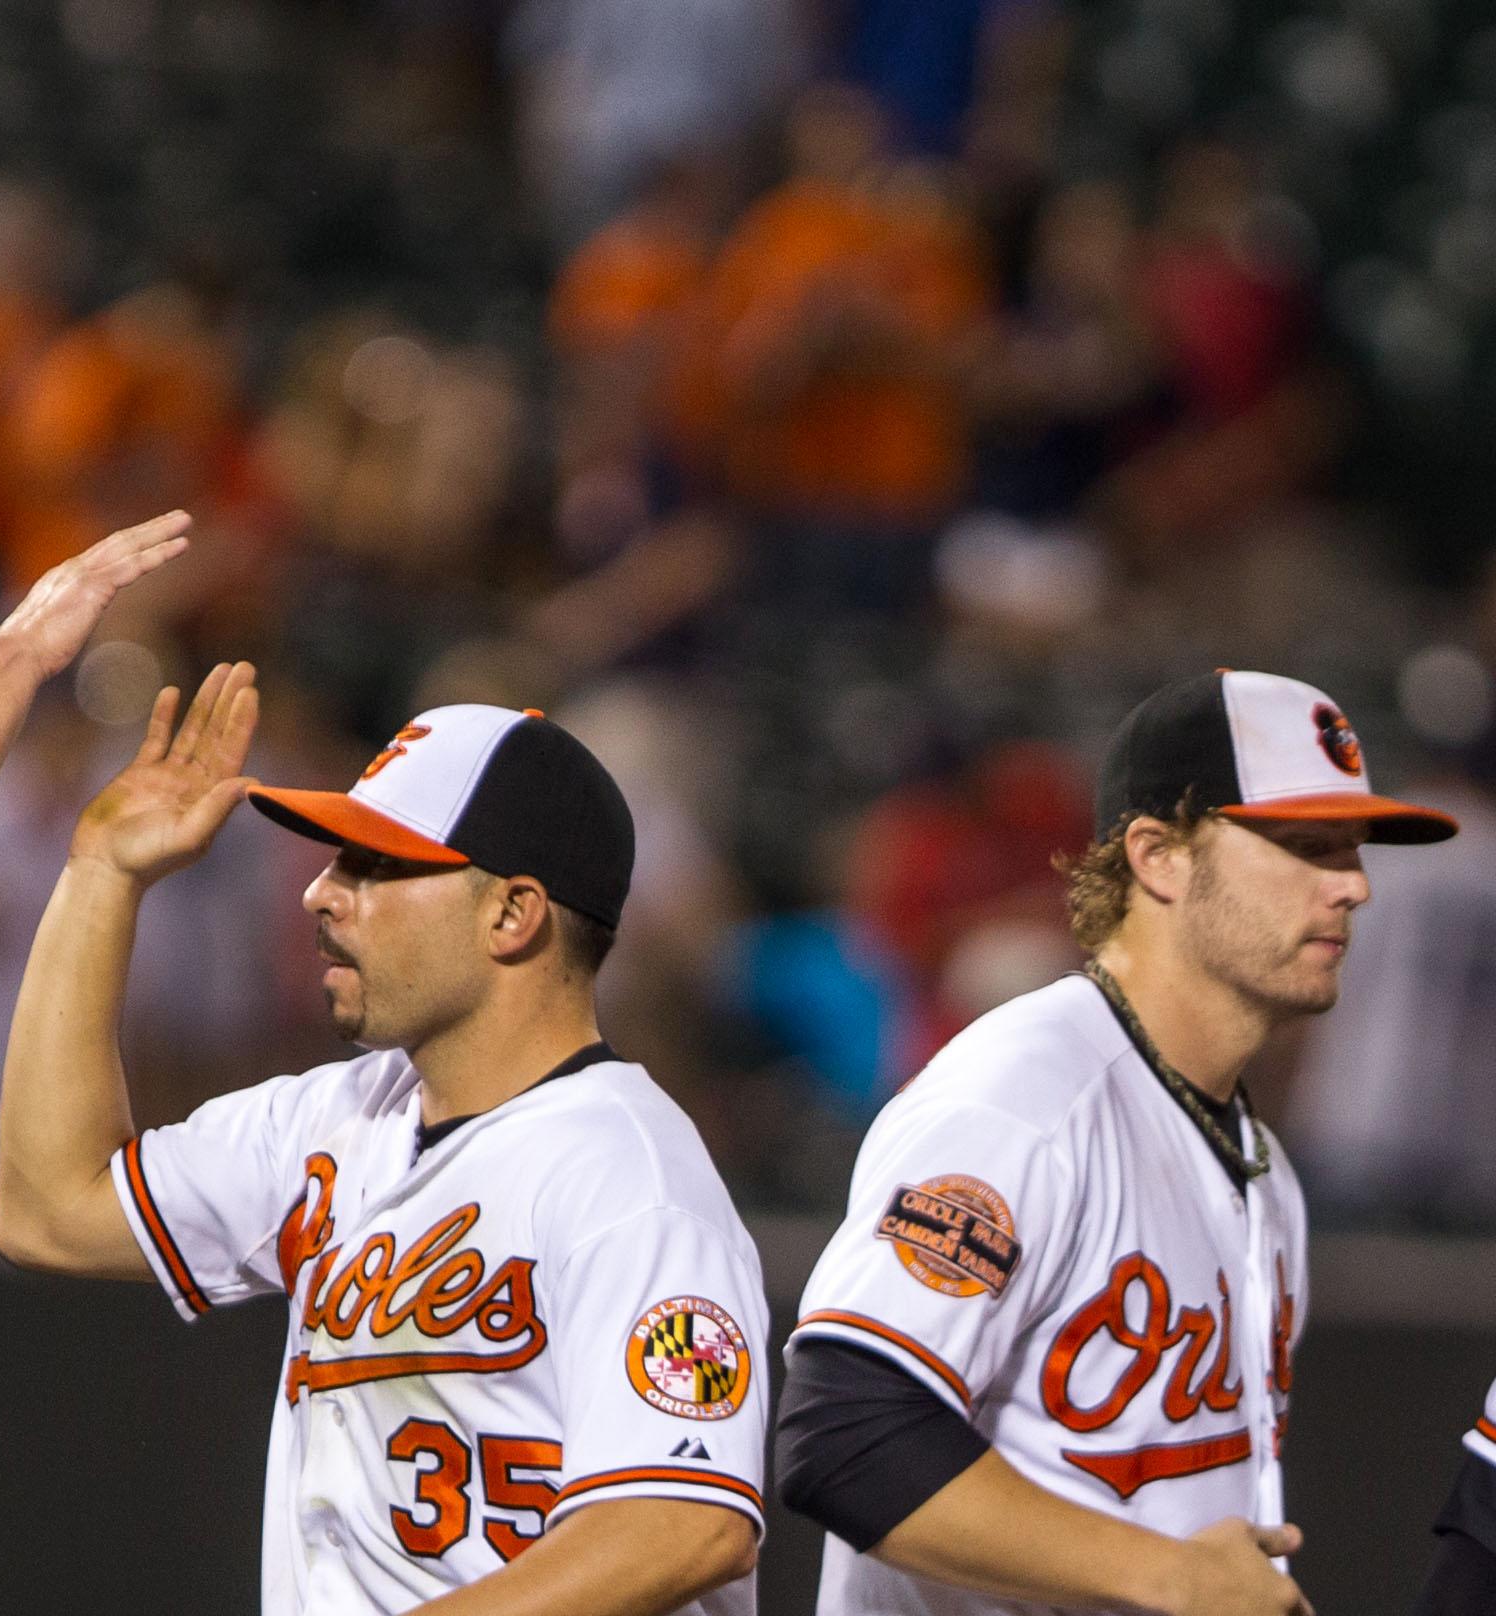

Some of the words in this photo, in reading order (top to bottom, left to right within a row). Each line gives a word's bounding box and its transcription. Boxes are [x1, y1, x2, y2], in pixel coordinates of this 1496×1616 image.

[633, 1298, 747, 1352] BALTIMORE
[645, 1388, 734, 1419] ORIOLES
[386, 1415, 563, 1563] 35
